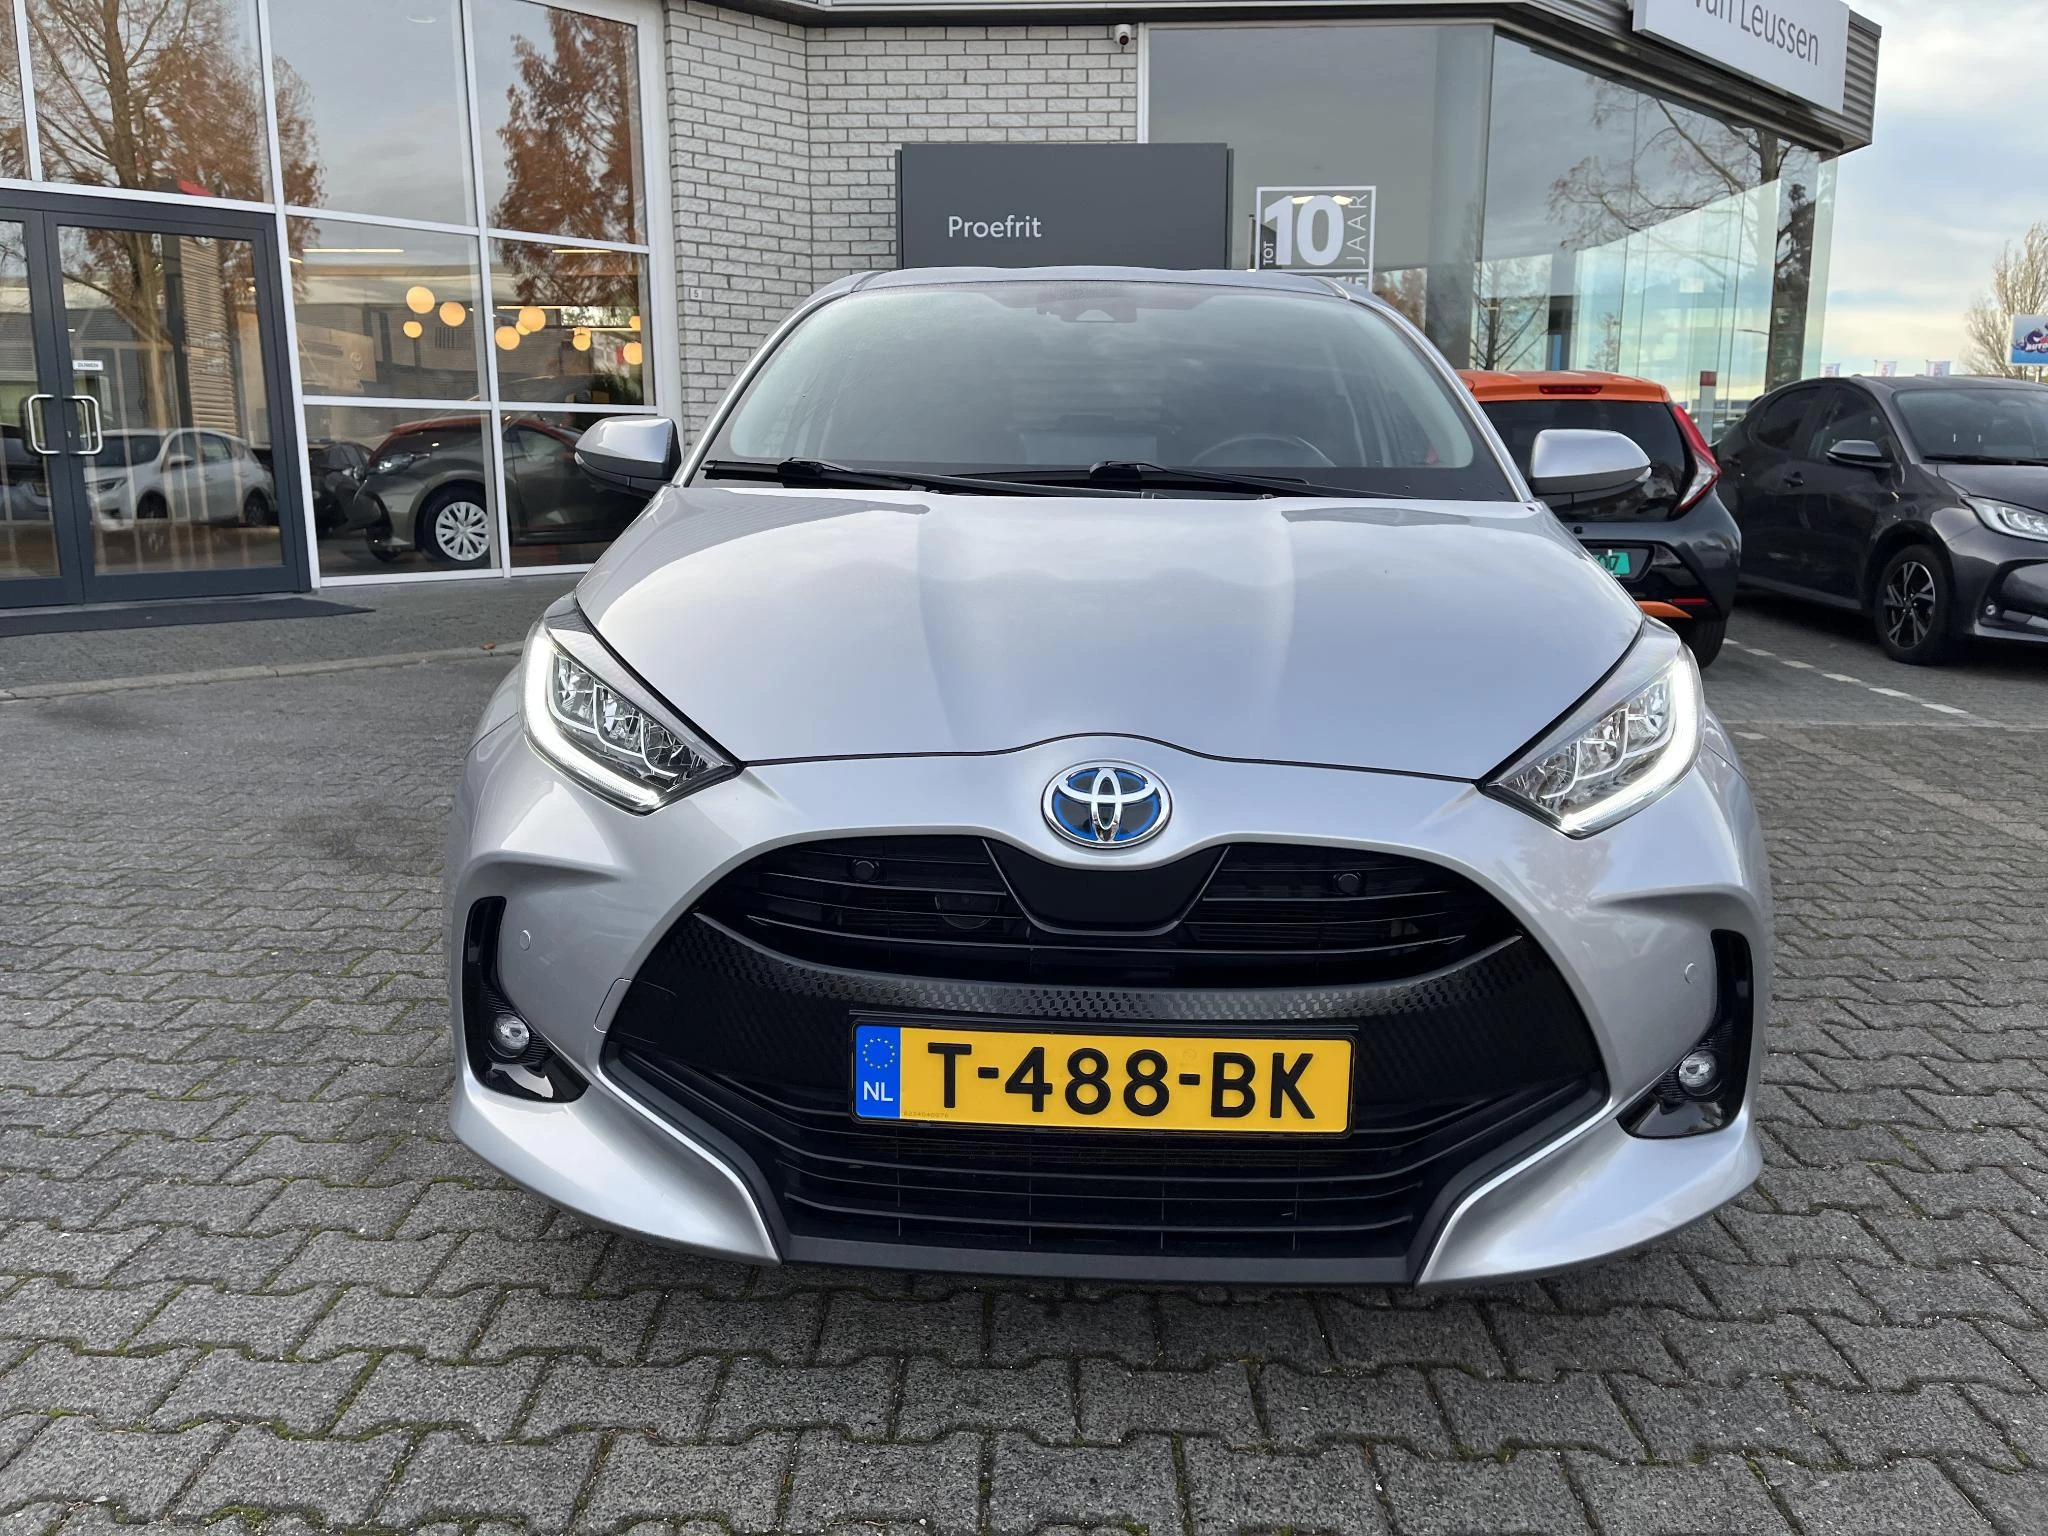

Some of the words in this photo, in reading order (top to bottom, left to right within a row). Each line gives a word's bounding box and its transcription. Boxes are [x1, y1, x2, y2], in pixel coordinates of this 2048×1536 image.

[1740, 0, 1819, 65] Leussen
[948, 214, 1042, 238] Proefrit
[1263, 240, 1274, 266] TOT
[1264, 194, 1344, 266] 10
[1345, 194, 1368, 266] JAAR
[863, 1080, 894, 1102] NL
[927, 1042, 1316, 1119] T-488-BK
